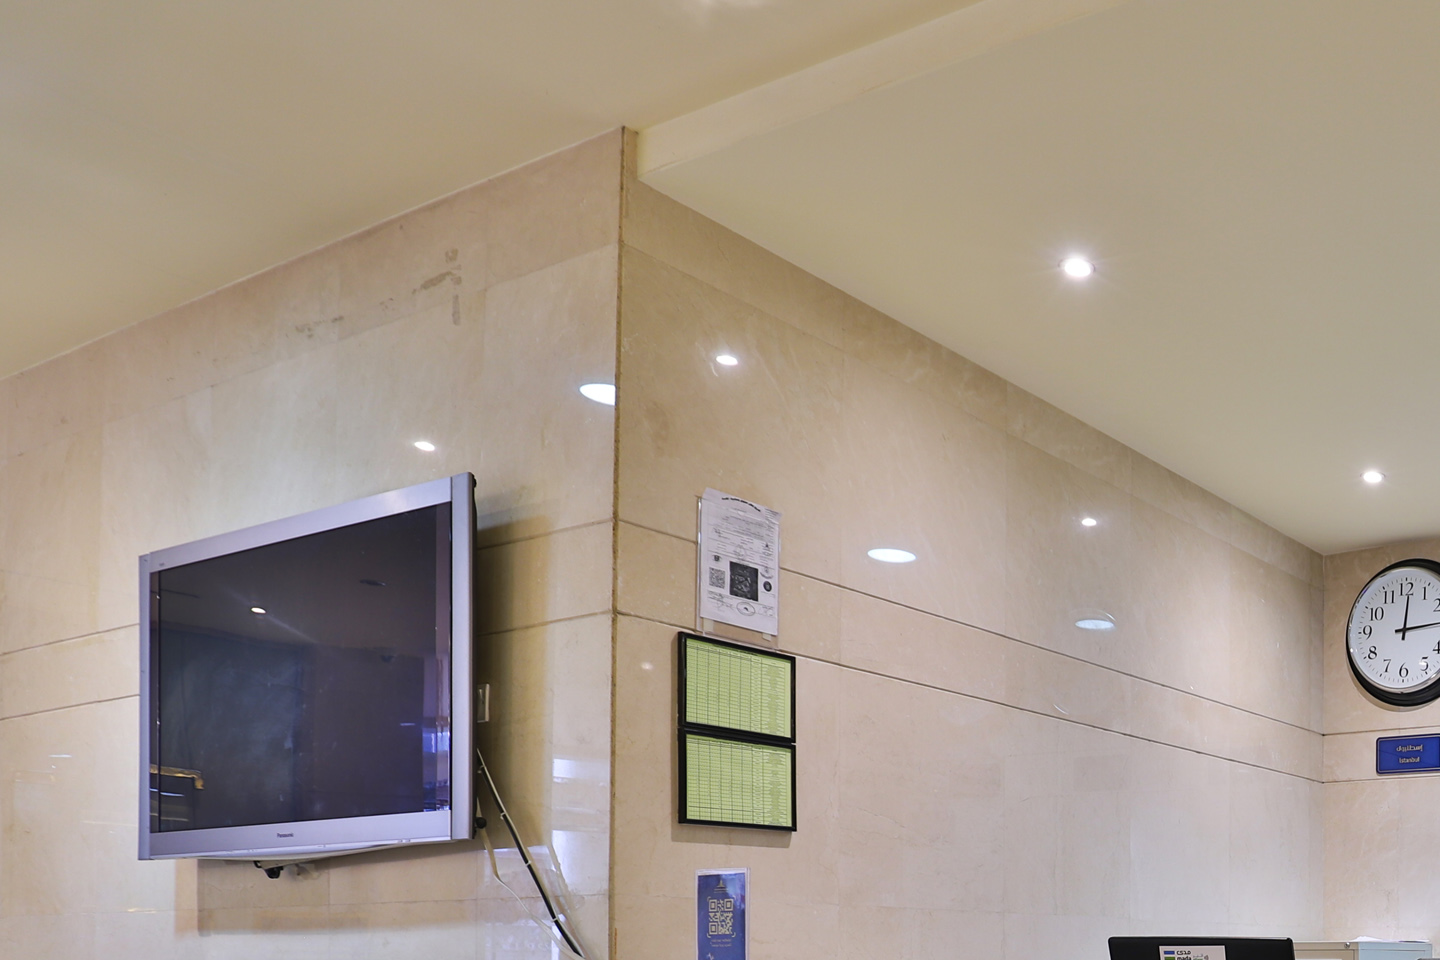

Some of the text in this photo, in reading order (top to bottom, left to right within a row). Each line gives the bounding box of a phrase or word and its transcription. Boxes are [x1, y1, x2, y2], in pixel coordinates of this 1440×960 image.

[1400, 582, 1414, 596] 12
[1422, 586, 1427, 600] 1
[1384, 590, 1395, 604] 11
[1370, 606, 1384, 621] 10
[1363, 625, 1372, 640] 9
[1368, 646, 1377, 660] 8
[1383, 659, 1391, 673] 7
[1399, 663, 1409, 678] 6
[1419, 656, 1429, 671] 5
